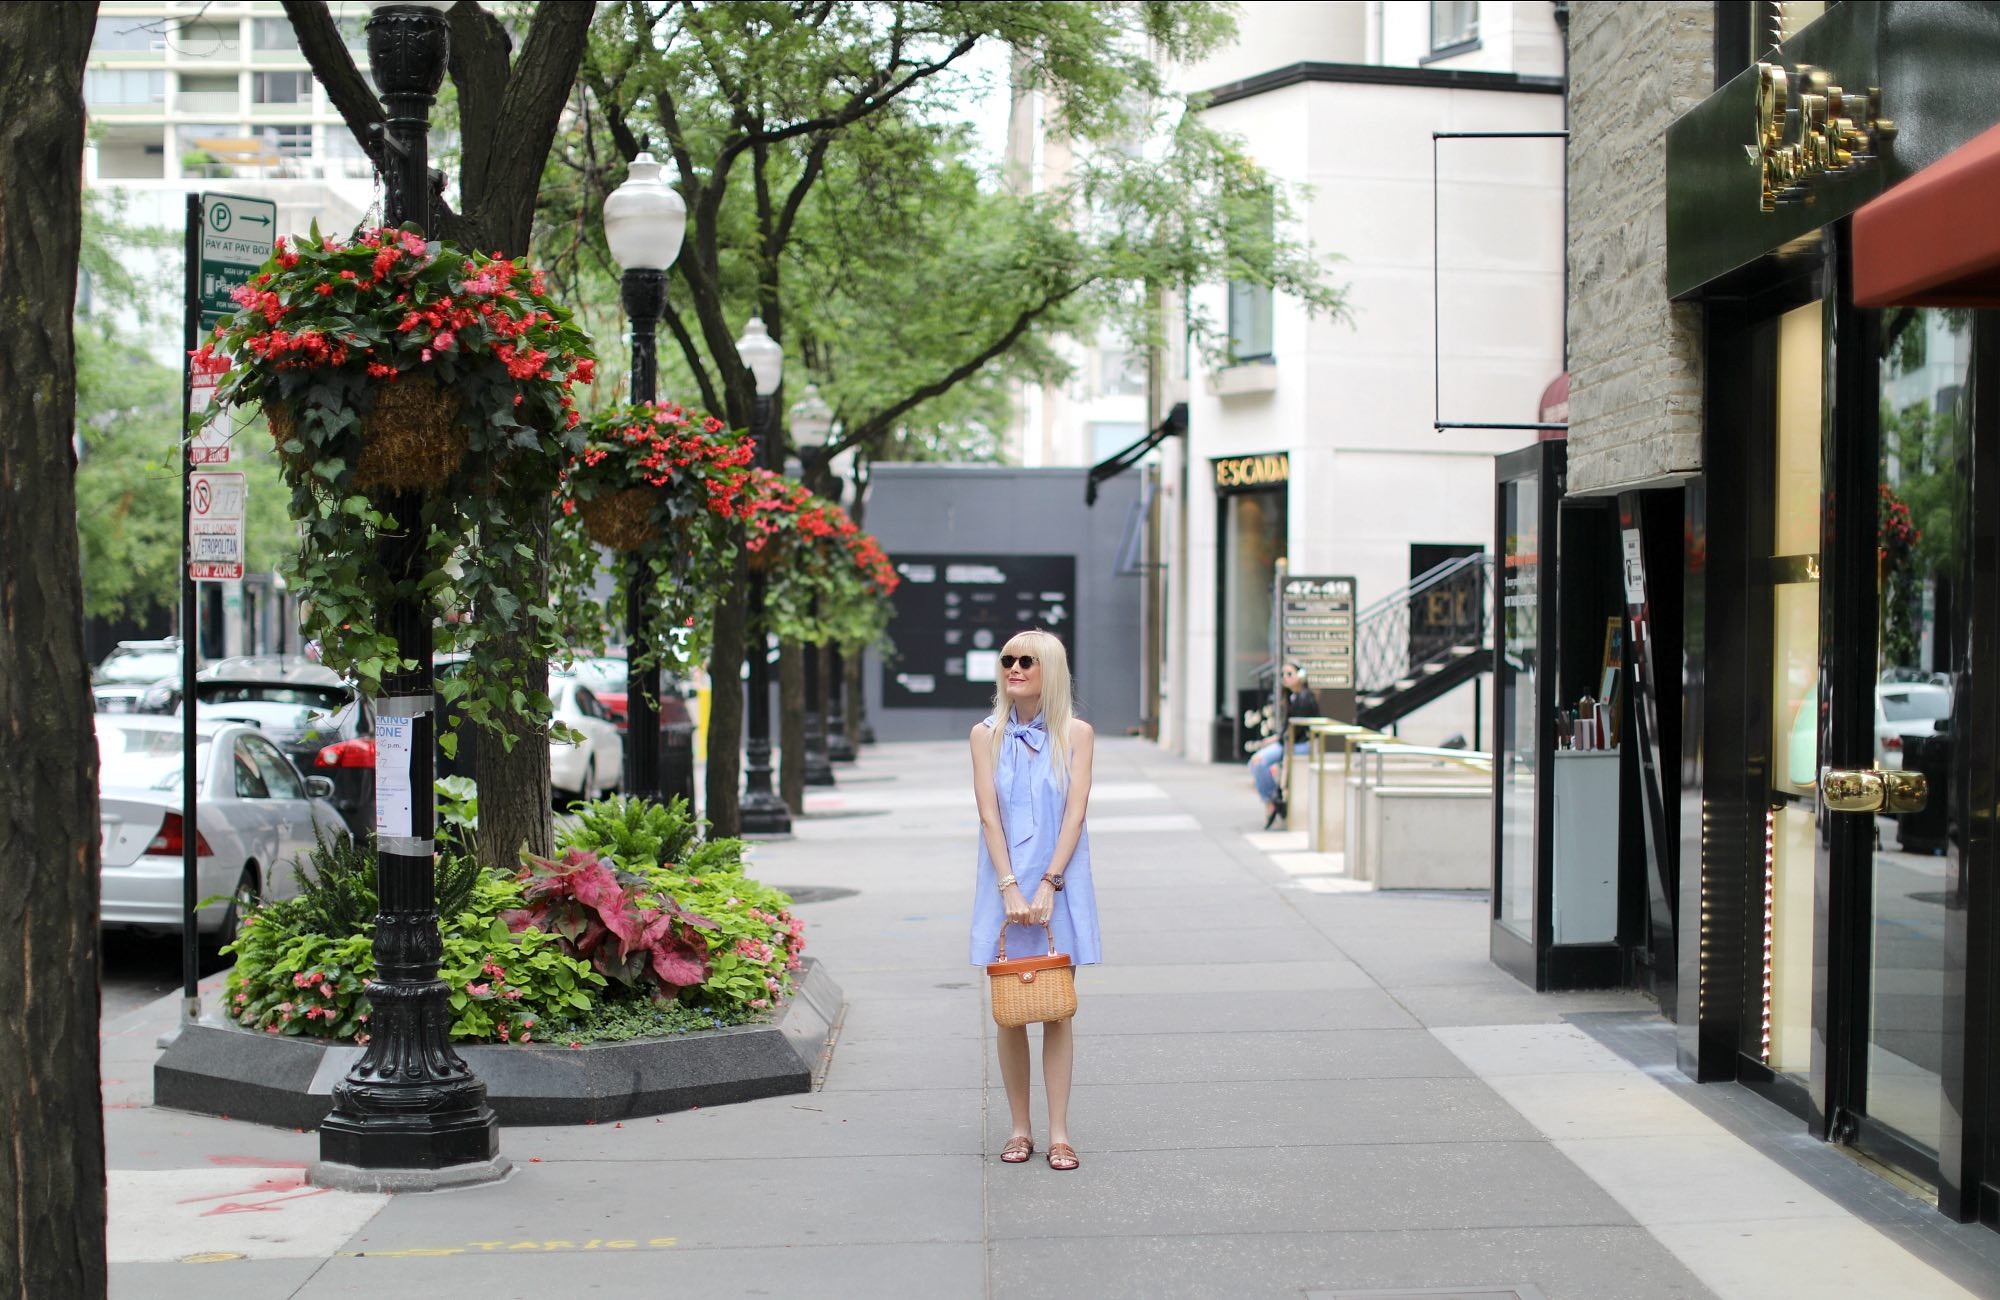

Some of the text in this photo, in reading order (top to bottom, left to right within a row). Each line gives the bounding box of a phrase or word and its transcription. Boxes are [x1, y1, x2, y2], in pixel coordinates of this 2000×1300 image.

[205, 239, 270, 255] PAY AT PAY BOX
[191, 448, 227, 462] TOW ZONE
[1216, 455, 1288, 486] ESCADA
[201, 538, 238, 555] ETROPOLITAN
[192, 564, 238, 578] TOW ZONE
[376, 726, 402, 738] ZONE
